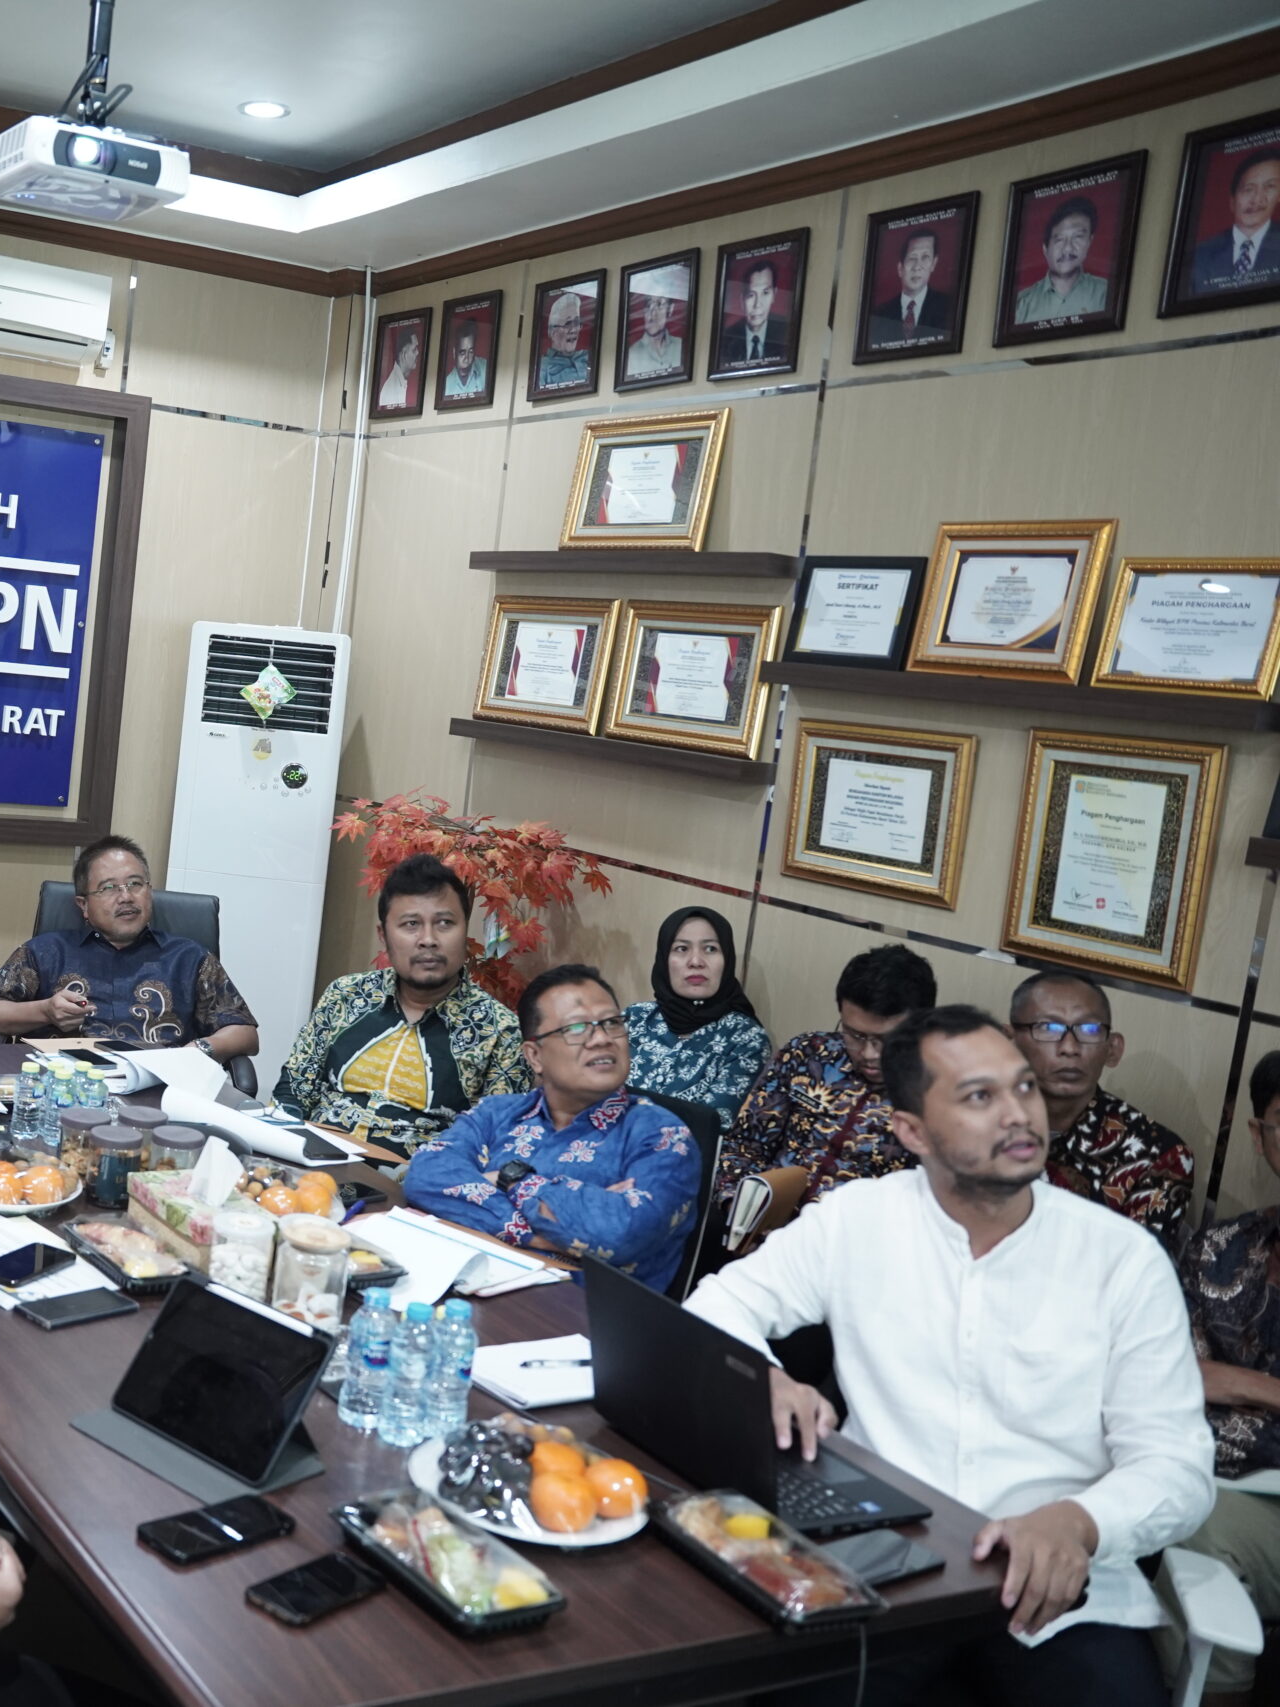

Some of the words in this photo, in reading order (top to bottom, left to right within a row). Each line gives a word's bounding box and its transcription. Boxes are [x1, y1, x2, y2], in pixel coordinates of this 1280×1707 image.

[837, 582, 879, 591] SERTIFIKAT
[1151, 599, 1183, 608] PIAGAM
[1185, 600, 1251, 609] PENGHARGAAN
[1080, 809, 1104, 820] Piagam
[1104, 812, 1146, 825] Penghargaan
